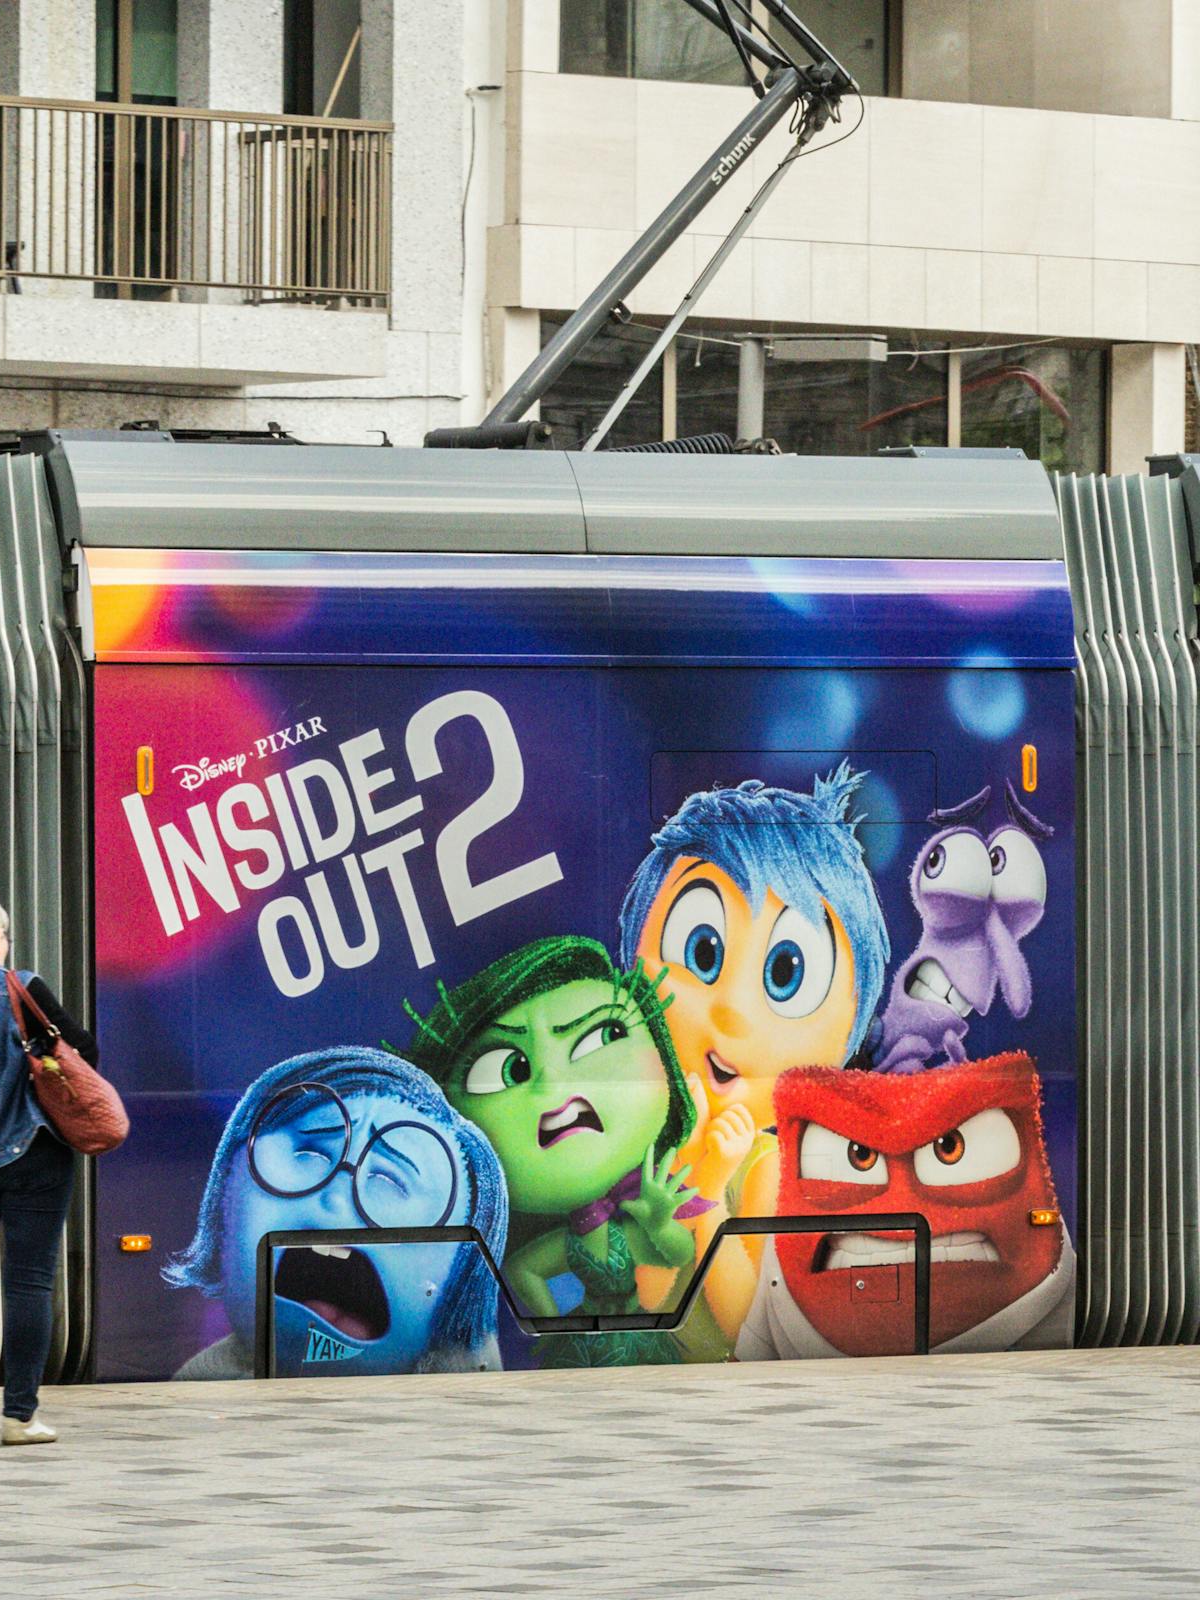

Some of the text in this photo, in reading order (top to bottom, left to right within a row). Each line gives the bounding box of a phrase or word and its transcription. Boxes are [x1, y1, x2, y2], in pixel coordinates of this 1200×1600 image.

[711, 132, 757, 186] schunk
[253, 715, 328, 760] PIXAR
[121, 728, 424, 938] INSIDE
[257, 690, 564, 998] OUT 2
[312, 1331, 346, 1361] YAY!
